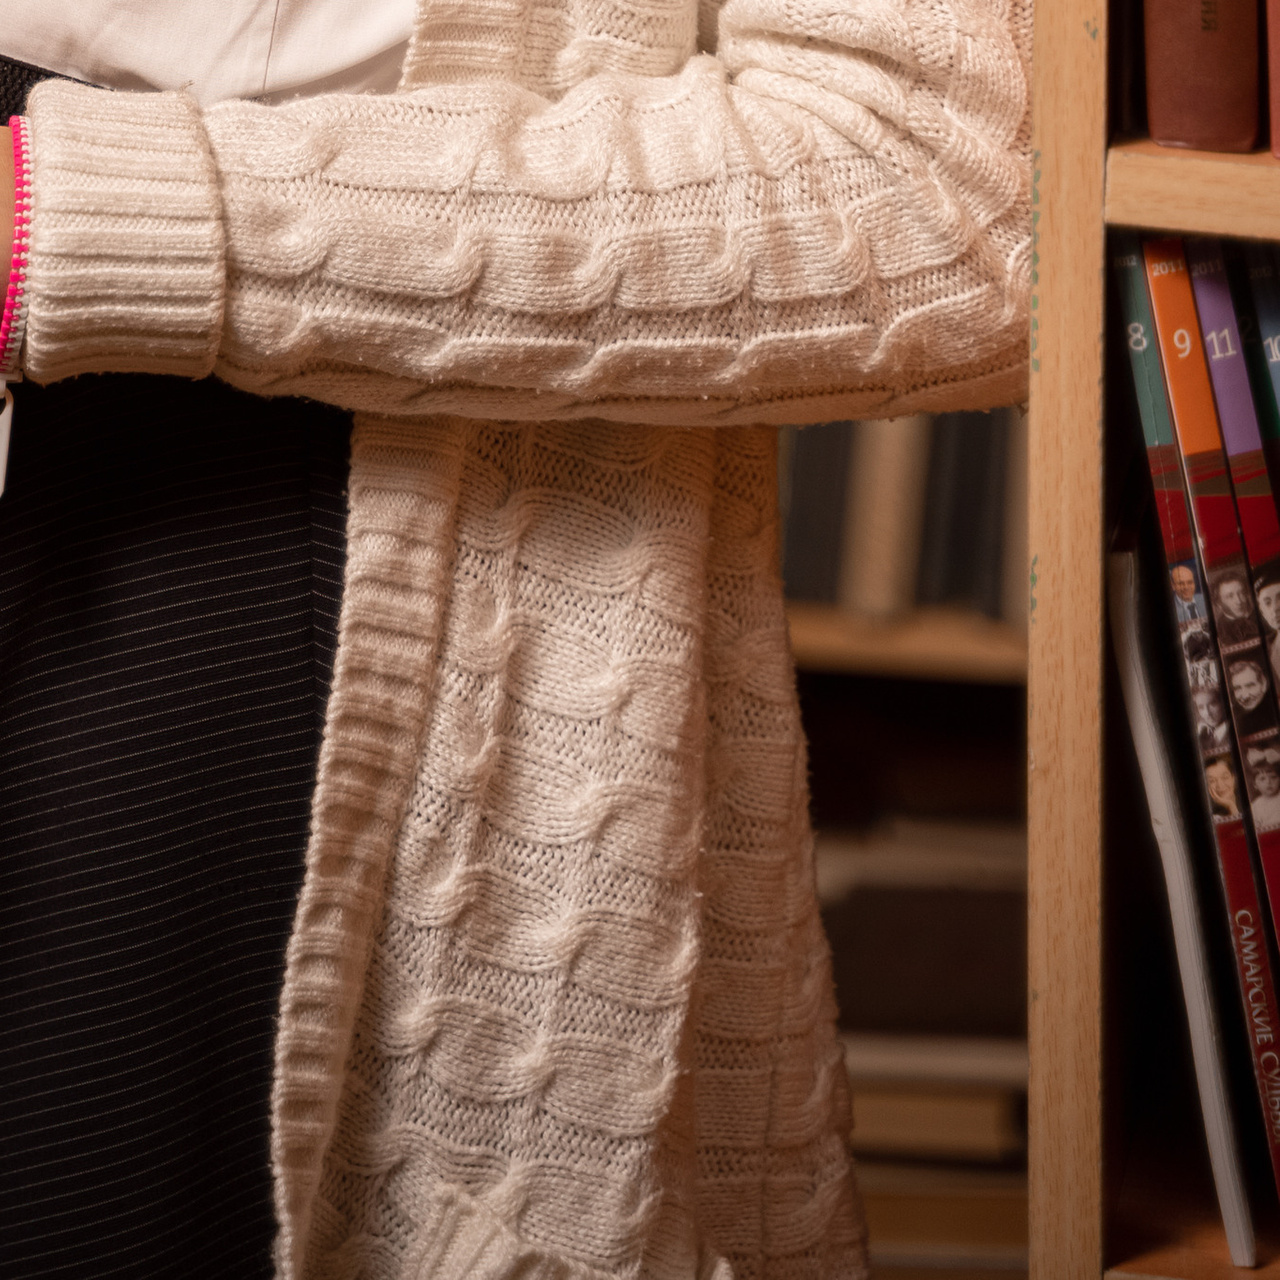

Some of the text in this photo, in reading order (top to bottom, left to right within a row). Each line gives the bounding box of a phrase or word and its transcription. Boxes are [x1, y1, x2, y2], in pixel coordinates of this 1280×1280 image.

[1151, 258, 1185, 277] 2011
[1126, 322, 1148, 351] 8
[1172, 328, 1193, 359] 9
[1204, 328, 1238, 360] 11
[1233, 908, 1274, 1046] САМАРСКИЕ
